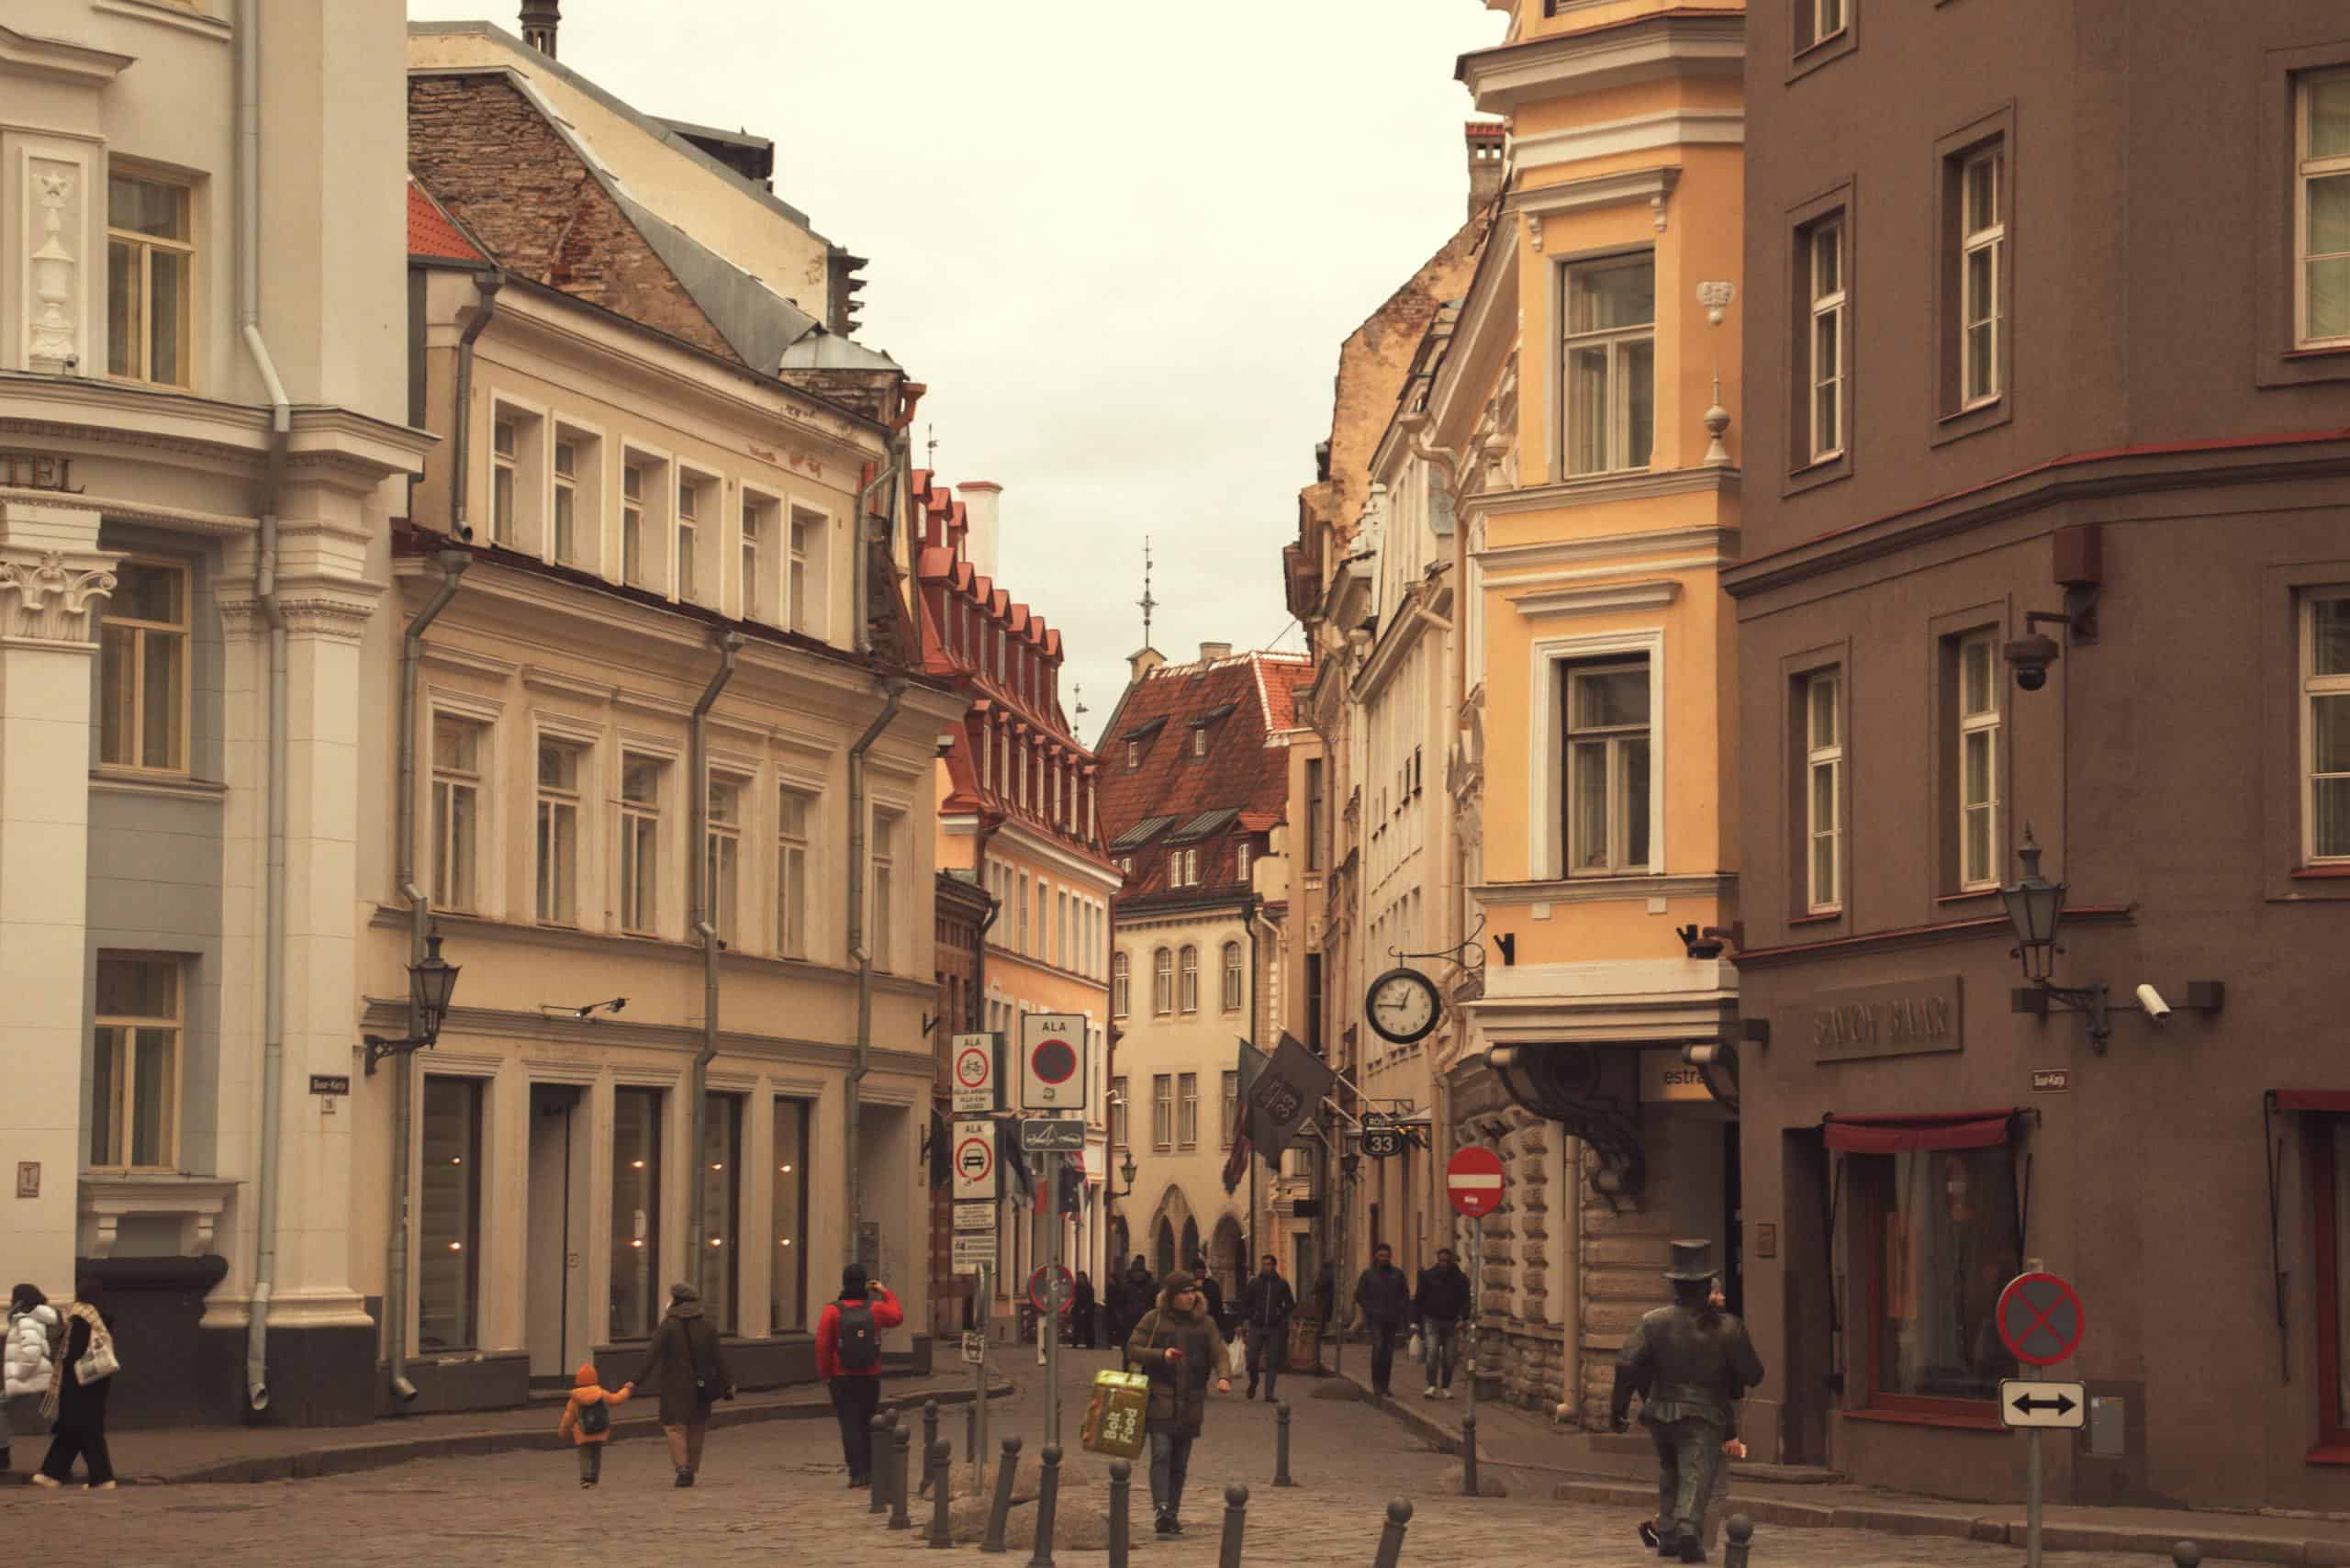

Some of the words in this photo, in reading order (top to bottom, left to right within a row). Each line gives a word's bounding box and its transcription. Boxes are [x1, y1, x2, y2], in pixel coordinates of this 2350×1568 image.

[1042, 1021, 1067, 1032] ALA
[964, 1037, 981, 1047] ALA
[964, 1124, 982, 1134] ALA
[1371, 1137, 1393, 1152] 33
[1102, 1411, 1122, 1440] Bolt
[1119, 1407, 1138, 1444] Food
